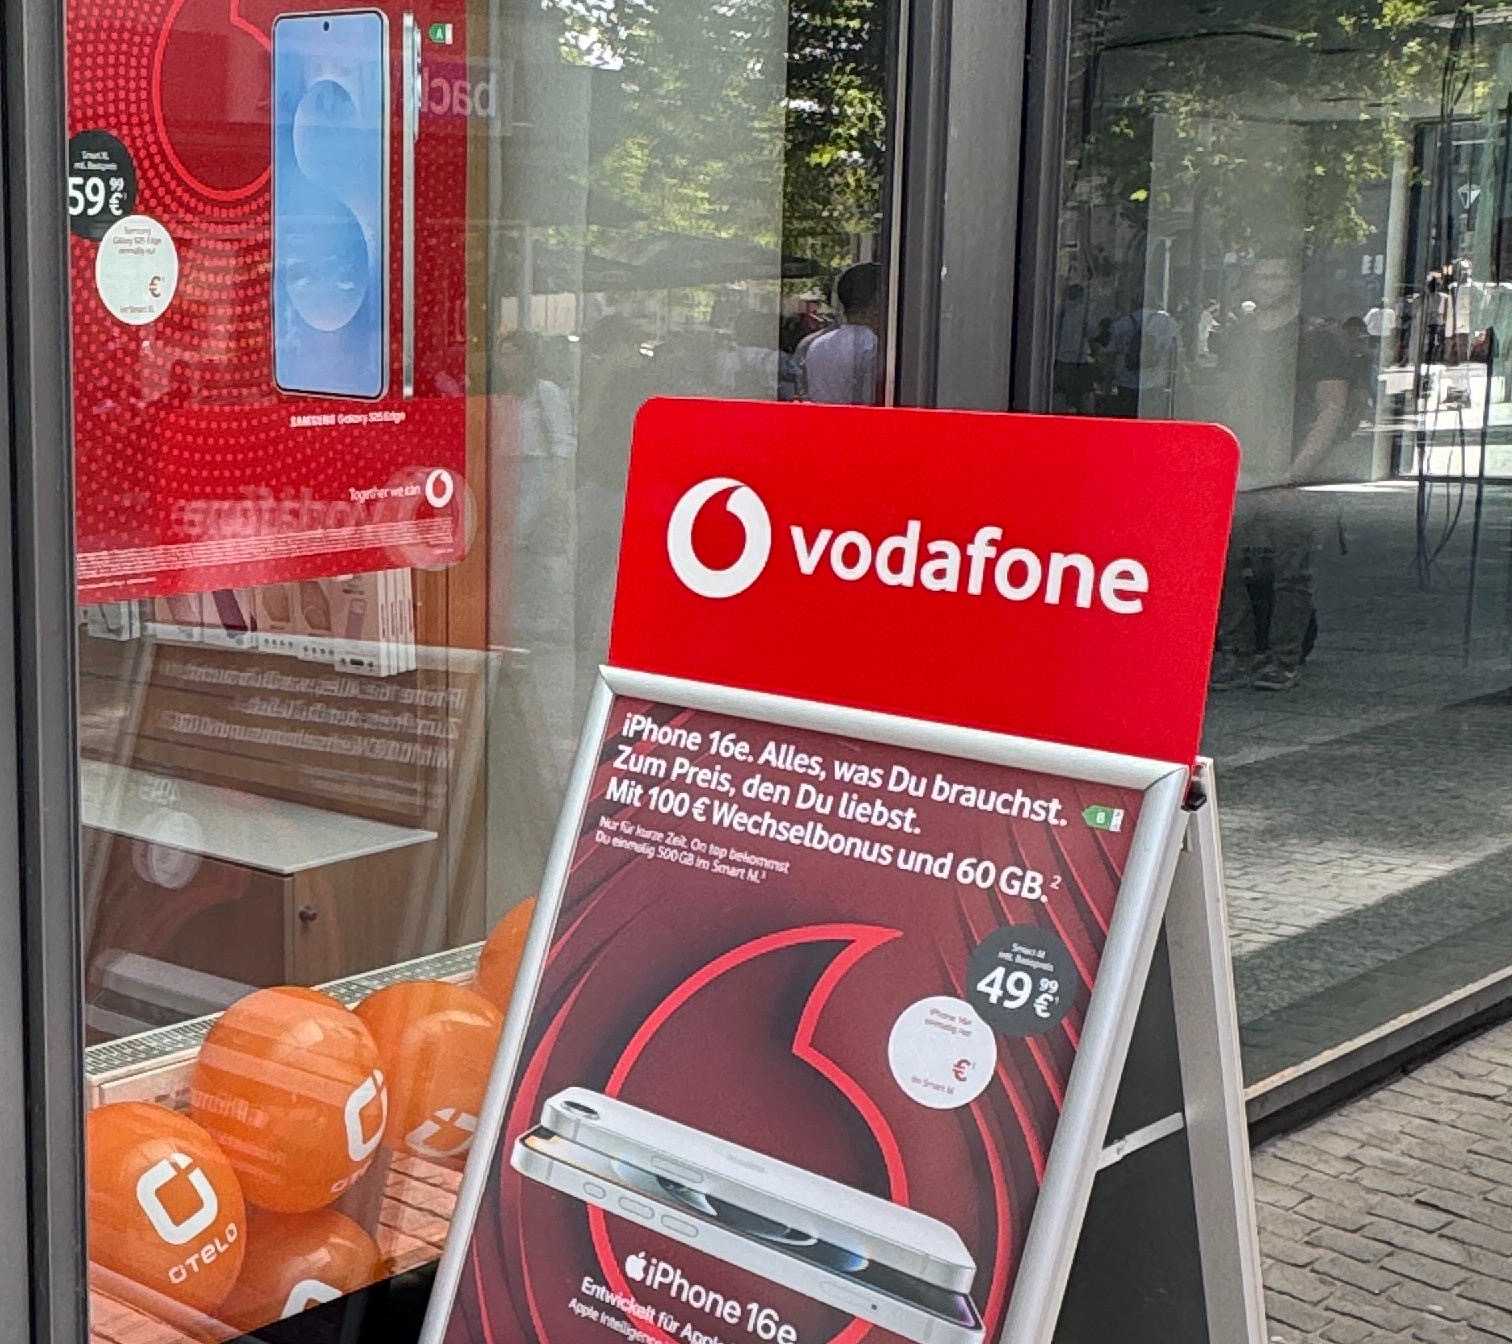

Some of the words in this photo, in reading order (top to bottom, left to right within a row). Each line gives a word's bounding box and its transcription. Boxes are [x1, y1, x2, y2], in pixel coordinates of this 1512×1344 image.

[68, 176, 106, 217] 59
[789, 519, 1150, 616] vodafone
[612, 744, 667, 779] Zum
[670, 756, 737, 797] Preis,
[742, 774, 791, 805] den
[794, 783, 834, 815] Du
[837, 791, 922, 835] liebst.
[621, 712, 702, 752] iPhone
[708, 730, 755, 763] 16e.
[757, 741, 827, 782] Alles,
[833, 759, 884, 790] was
[887, 764, 927, 799] Du
[930, 773, 1069, 827] brauchst.
[594, 829, 611, 845] Du
[611, 833, 656, 861] einmalig
[656, 846, 679, 864] 500
[678, 850, 695, 867] GB
[694, 854, 711, 871] im
[710, 858, 746, 881] Smart
[598, 814, 620, 832] Nur
[619, 819, 636, 836] für
[635, 824, 665, 843] kurze
[665, 830, 690, 850] Zeit.
[690, 837, 708, 853] On
[707, 842, 728, 861] top
[727, 846, 791, 875] bekommst
[604, 776, 644, 808] Mit
[647, 786, 691, 819] 100
[691, 796, 711, 823] €
[712, 798, 895, 867] Wechselbonus
[896, 847, 955, 880] und
[955, 856, 997, 889] 60
[976, 965, 1034, 1010] 49
[1038, 977, 1061, 995] 99
[567, 1296, 600, 1324] Apple
[580, 1275, 658, 1325] Entwickelt
[657, 1307, 681, 1336] für
[644, 1257, 743, 1325] iPhone
